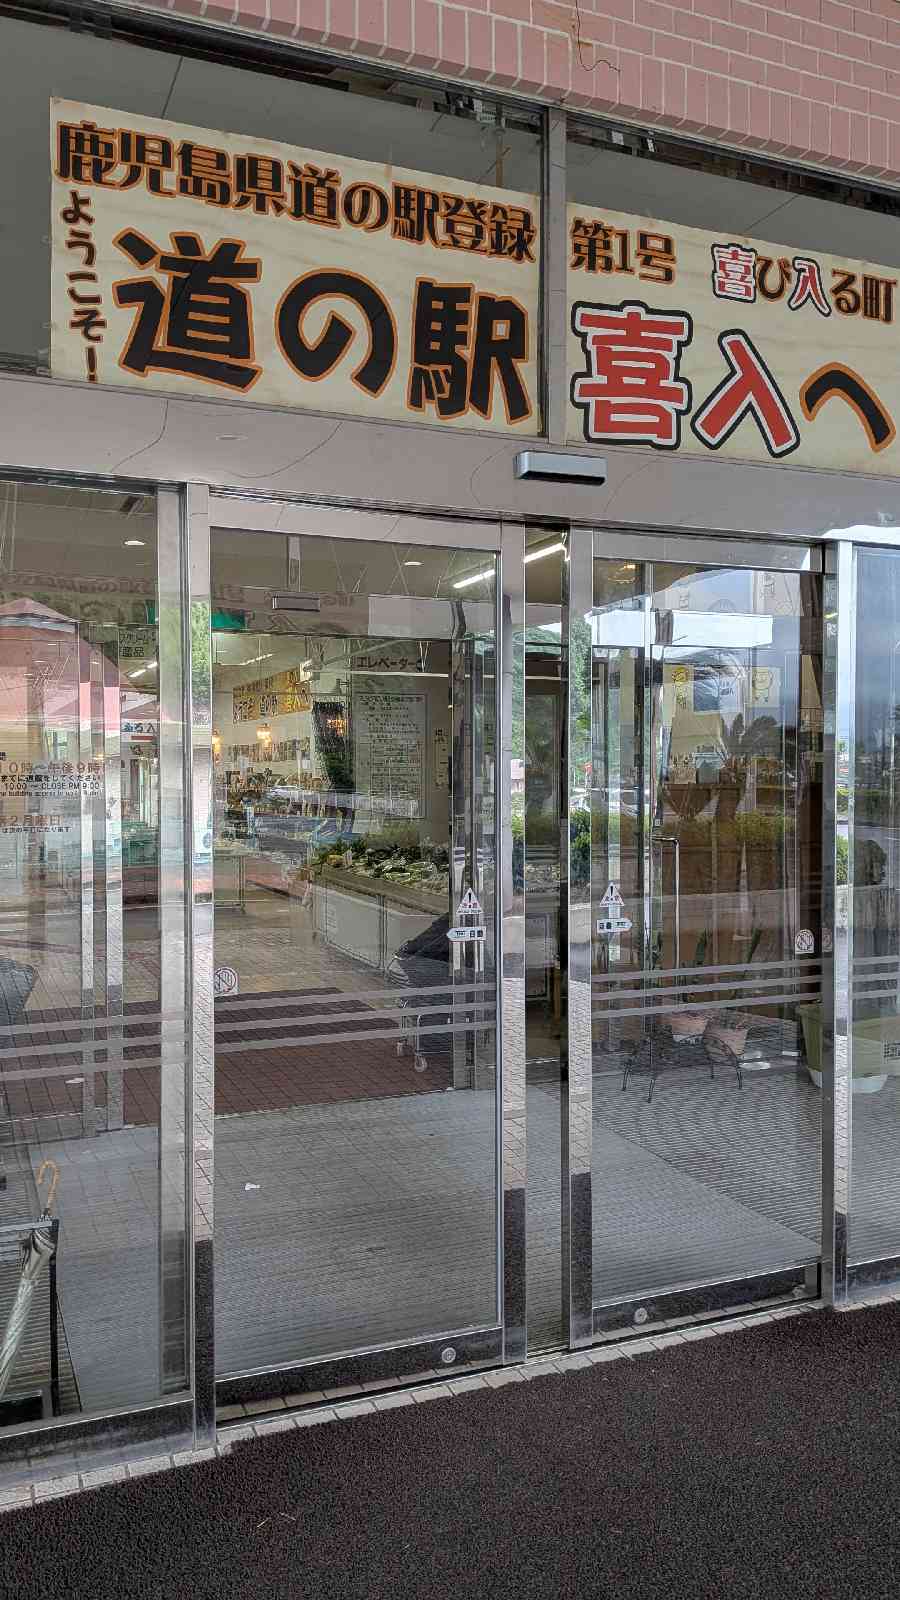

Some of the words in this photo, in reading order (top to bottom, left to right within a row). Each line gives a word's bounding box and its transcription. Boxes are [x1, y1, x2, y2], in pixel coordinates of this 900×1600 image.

[54, 120, 536, 263] 鹿児島県道の駅登録
[112, 227, 534, 426] 道の駅
[569, 300, 897, 459] 喜入へ
[711, 243, 898, 324] 喜び入る町
